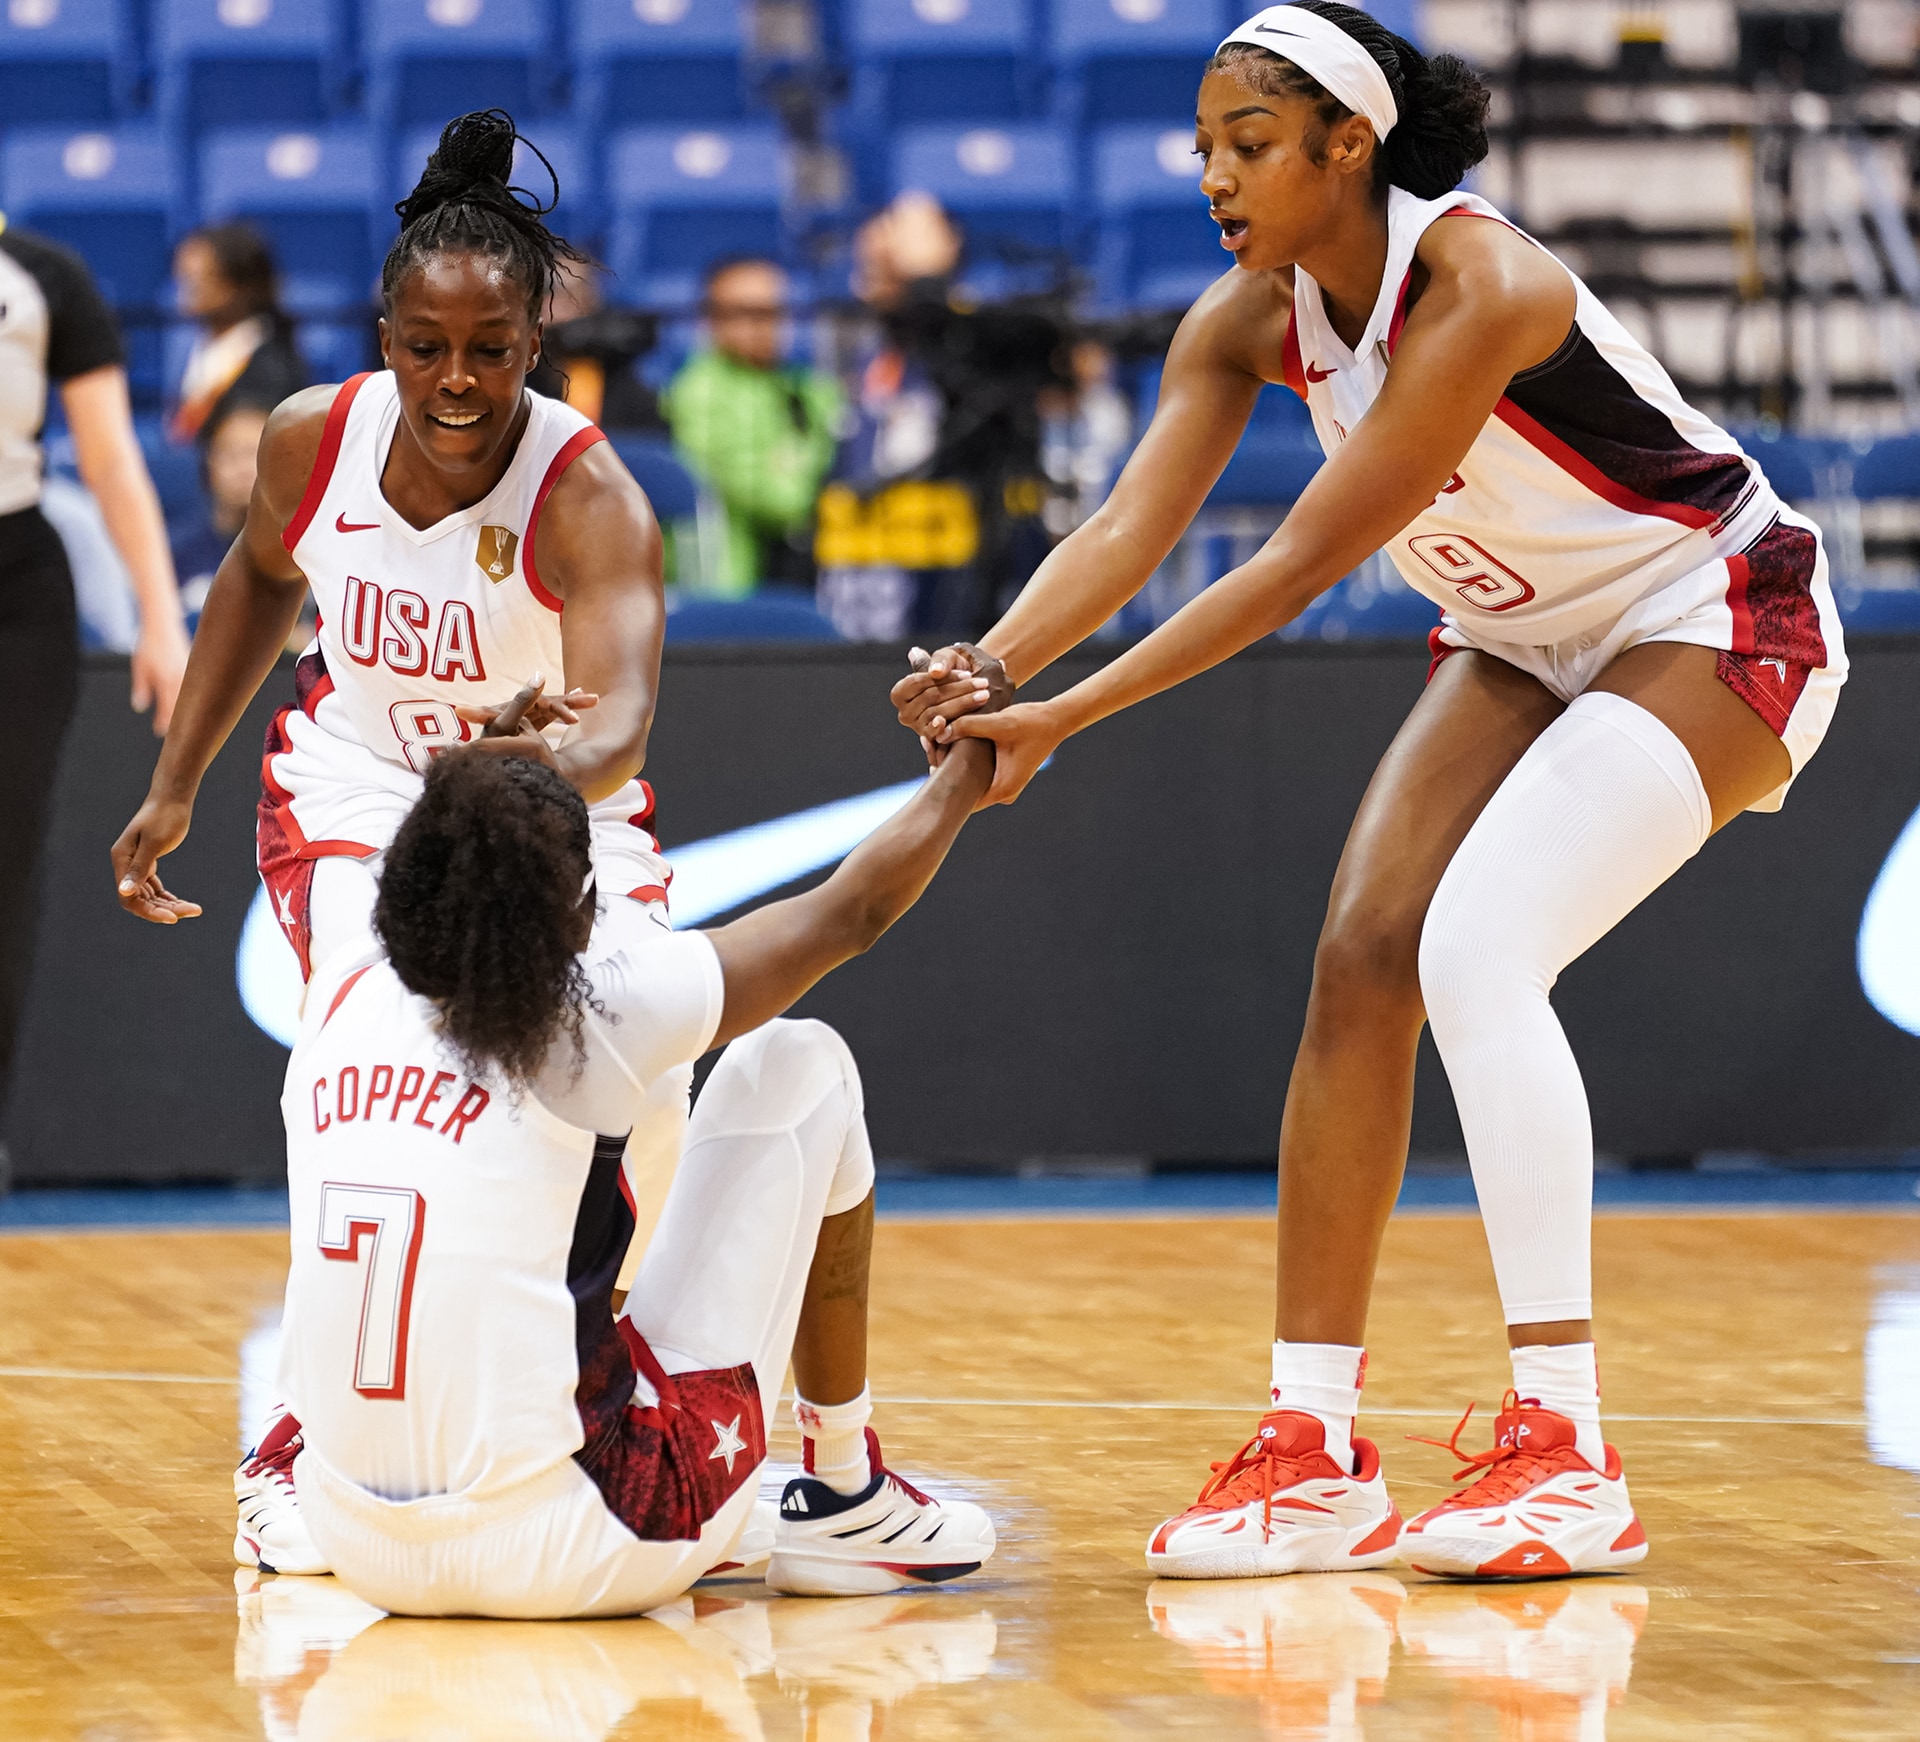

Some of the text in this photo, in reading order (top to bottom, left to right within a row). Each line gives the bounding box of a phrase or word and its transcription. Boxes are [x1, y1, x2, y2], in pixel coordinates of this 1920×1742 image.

[1408, 533, 1536, 612] 9
[342, 575, 487, 682] USA
[389, 699, 471, 774] 8
[313, 1064, 490, 1145] COPPER
[318, 1181, 426, 1401] 7
